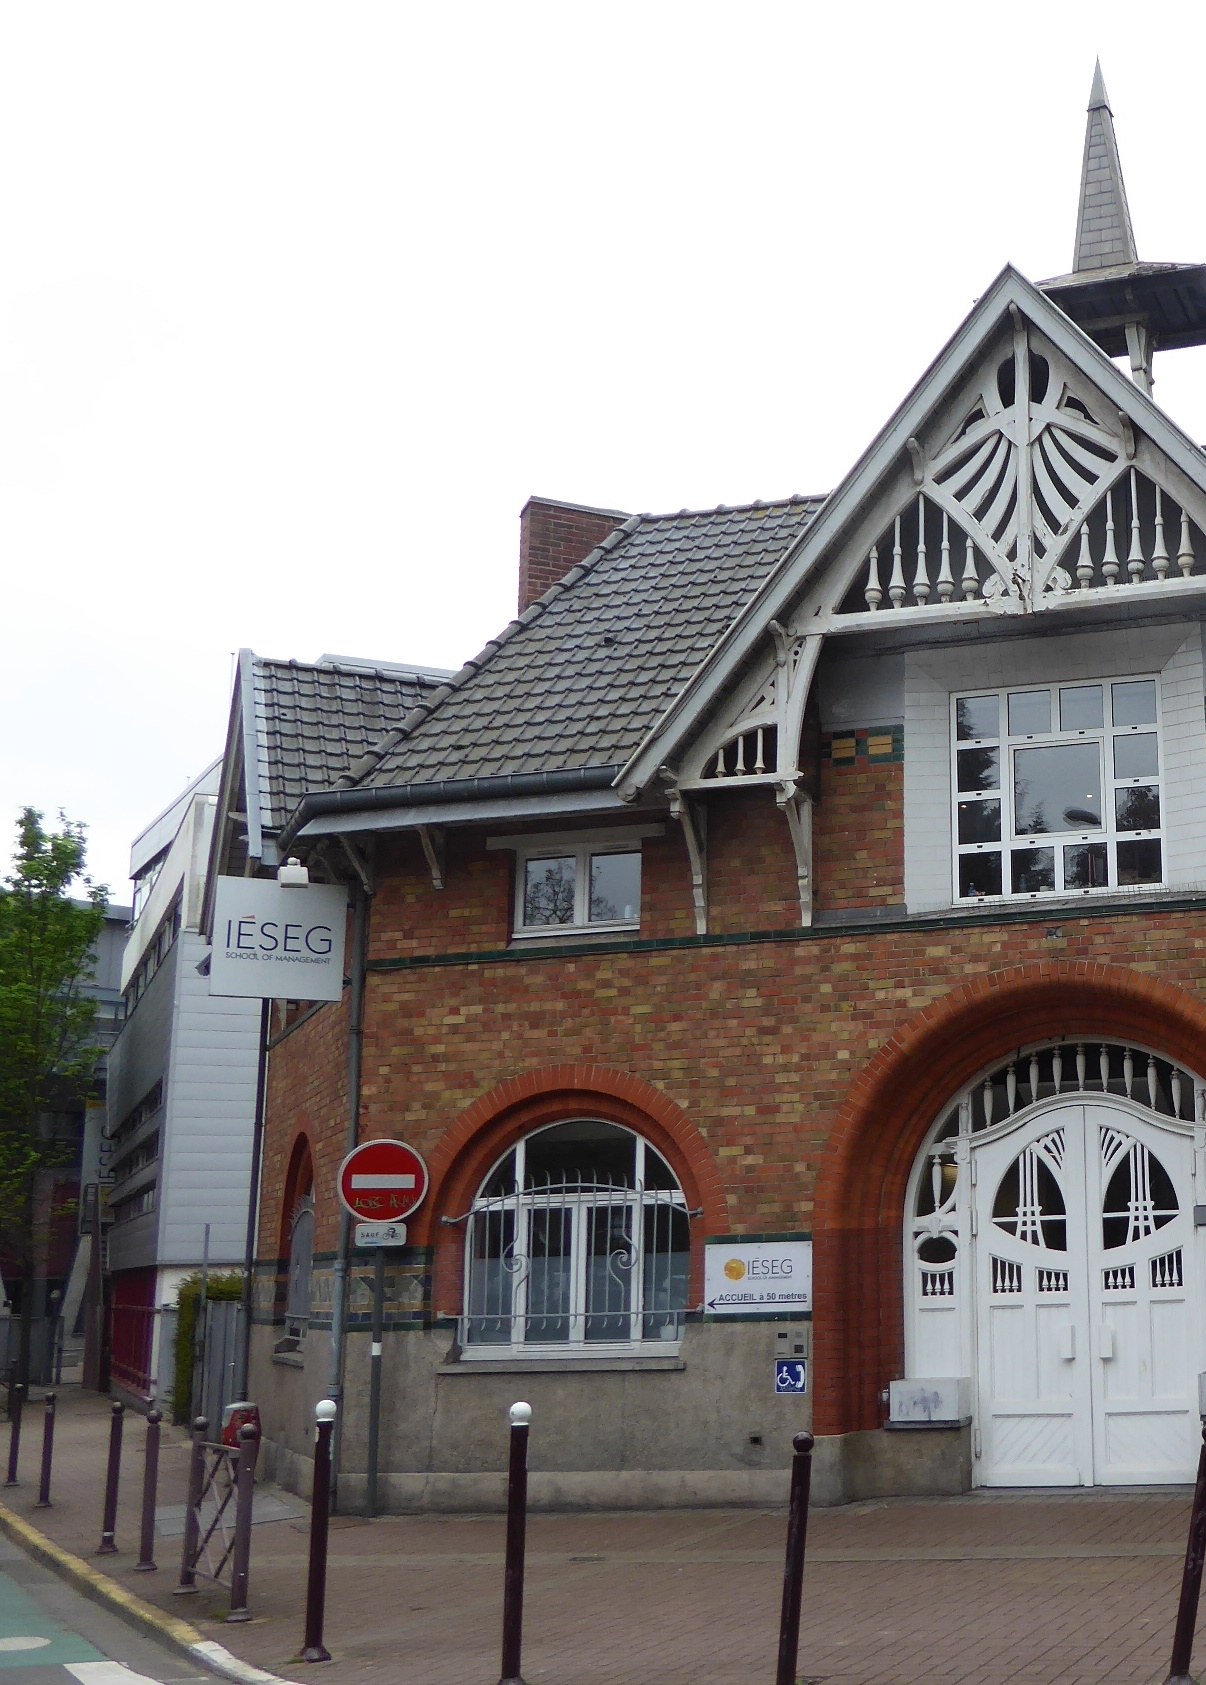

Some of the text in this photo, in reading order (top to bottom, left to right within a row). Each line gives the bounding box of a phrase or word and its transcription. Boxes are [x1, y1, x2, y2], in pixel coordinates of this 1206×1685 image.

[226, 915, 332, 955] IÉSEG
[225, 951, 259, 961] SCHOOL
[275, 955, 331, 964] MANAGEMENT
[747, 1257, 793, 1275] IÉSEG
[718, 1293, 757, 1301] ACCUEIL
[766, 1292, 776, 1300] 50
